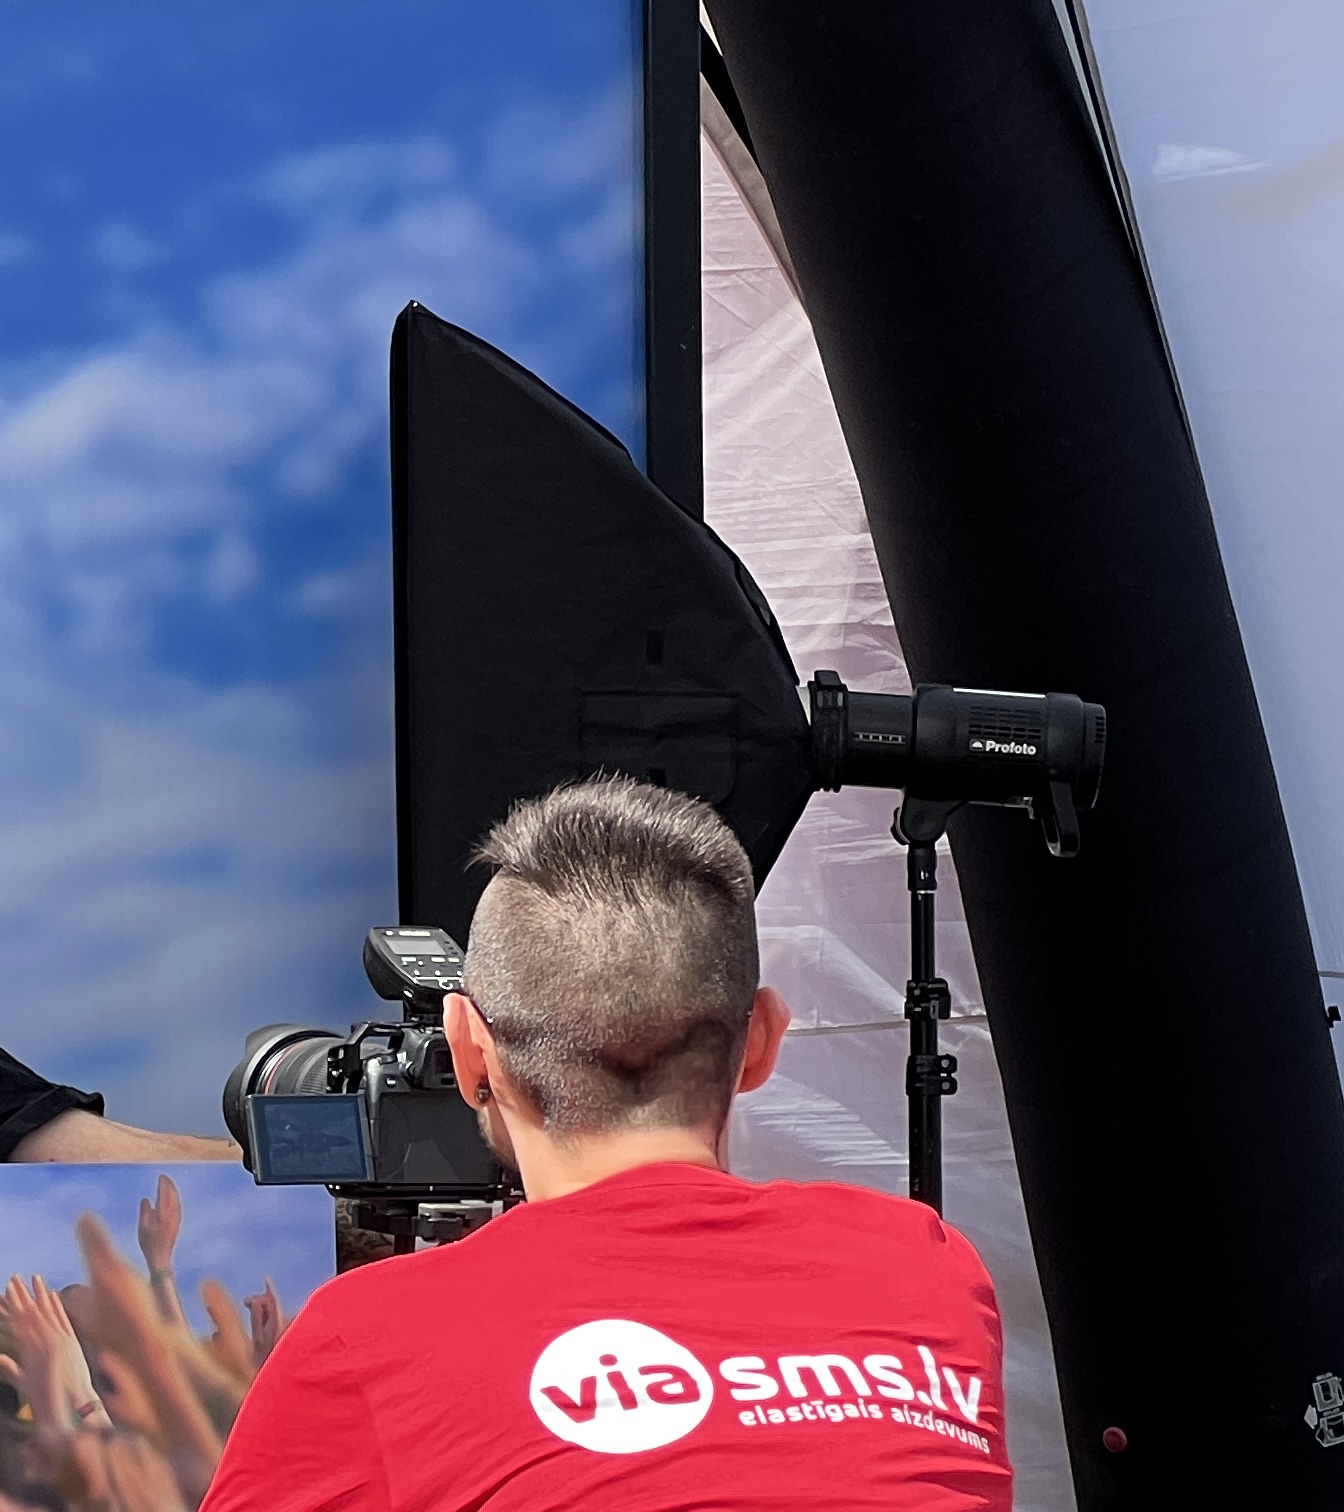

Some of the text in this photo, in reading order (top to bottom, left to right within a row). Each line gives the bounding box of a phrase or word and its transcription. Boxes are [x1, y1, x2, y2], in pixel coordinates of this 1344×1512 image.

[985, 740, 1037, 755] Profoto
[540, 1345, 981, 1424] via sms.lv
[739, 1398, 991, 1454] elastīgais aizdevums
